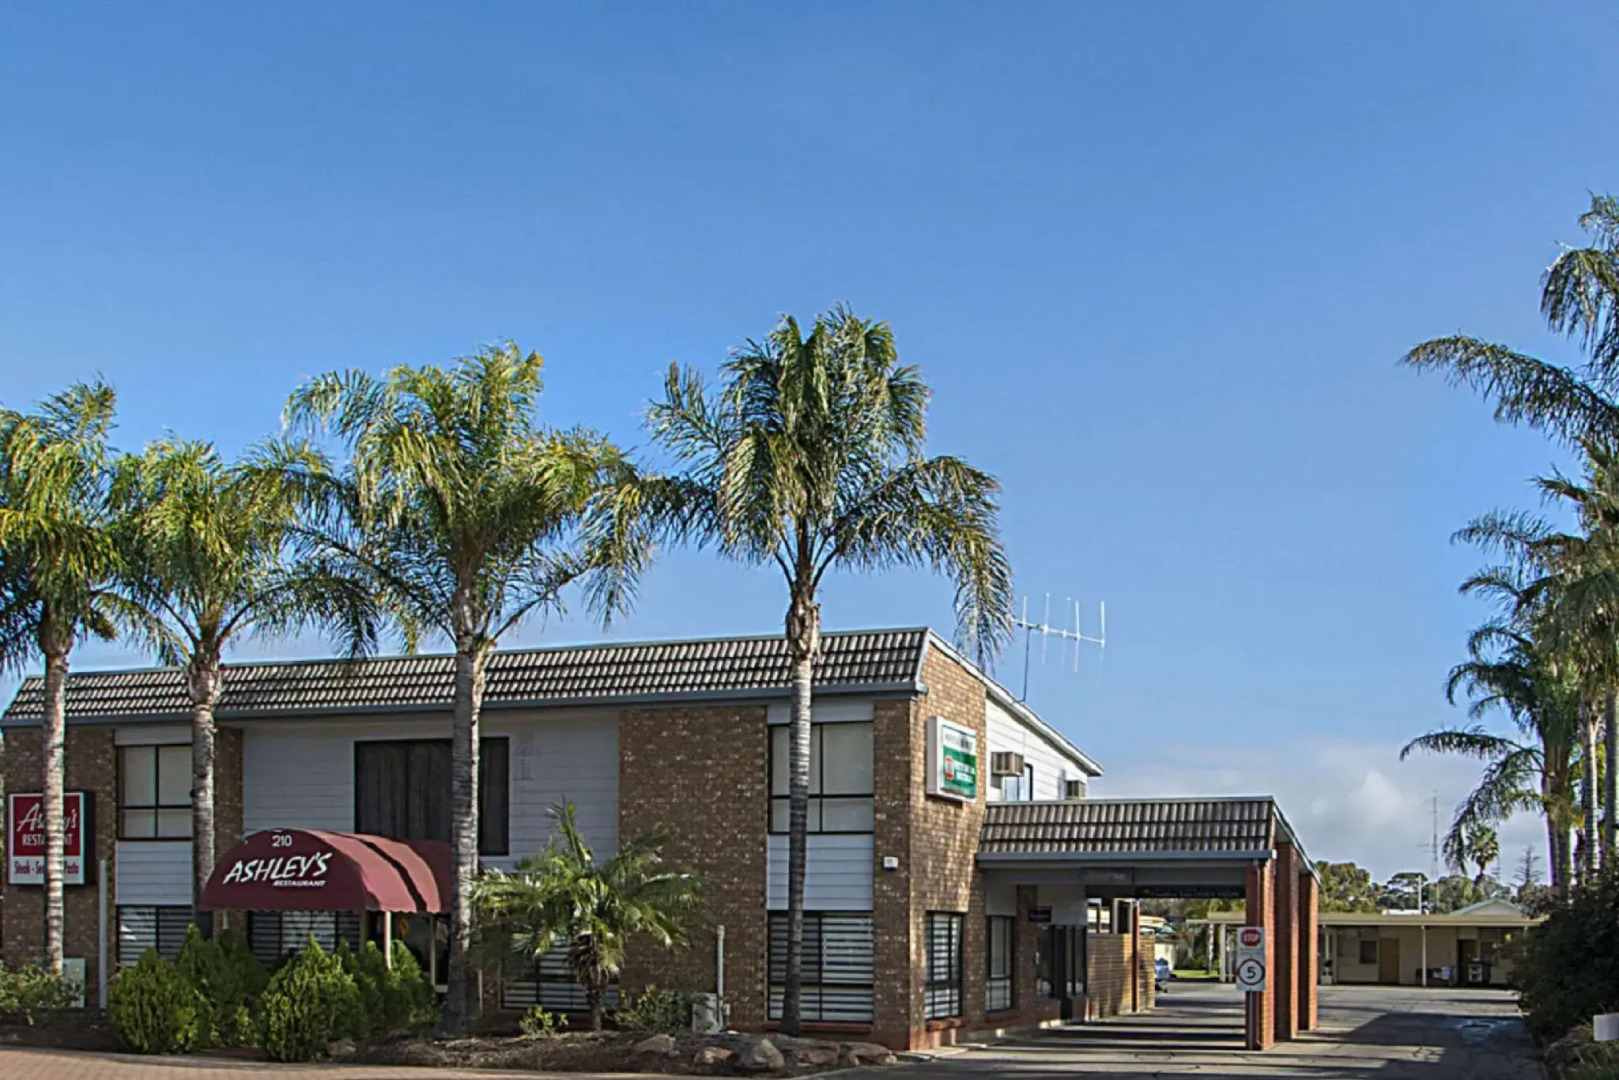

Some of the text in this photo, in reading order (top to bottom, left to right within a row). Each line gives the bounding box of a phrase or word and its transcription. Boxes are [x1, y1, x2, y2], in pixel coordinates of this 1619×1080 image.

[16, 802, 77, 832] Asy's
[22, 833, 73, 846] RESTNT
[271, 835, 293, 848] 210
[222, 852, 333, 885] ASHLEY'S
[1246, 966, 1256, 979] 5
